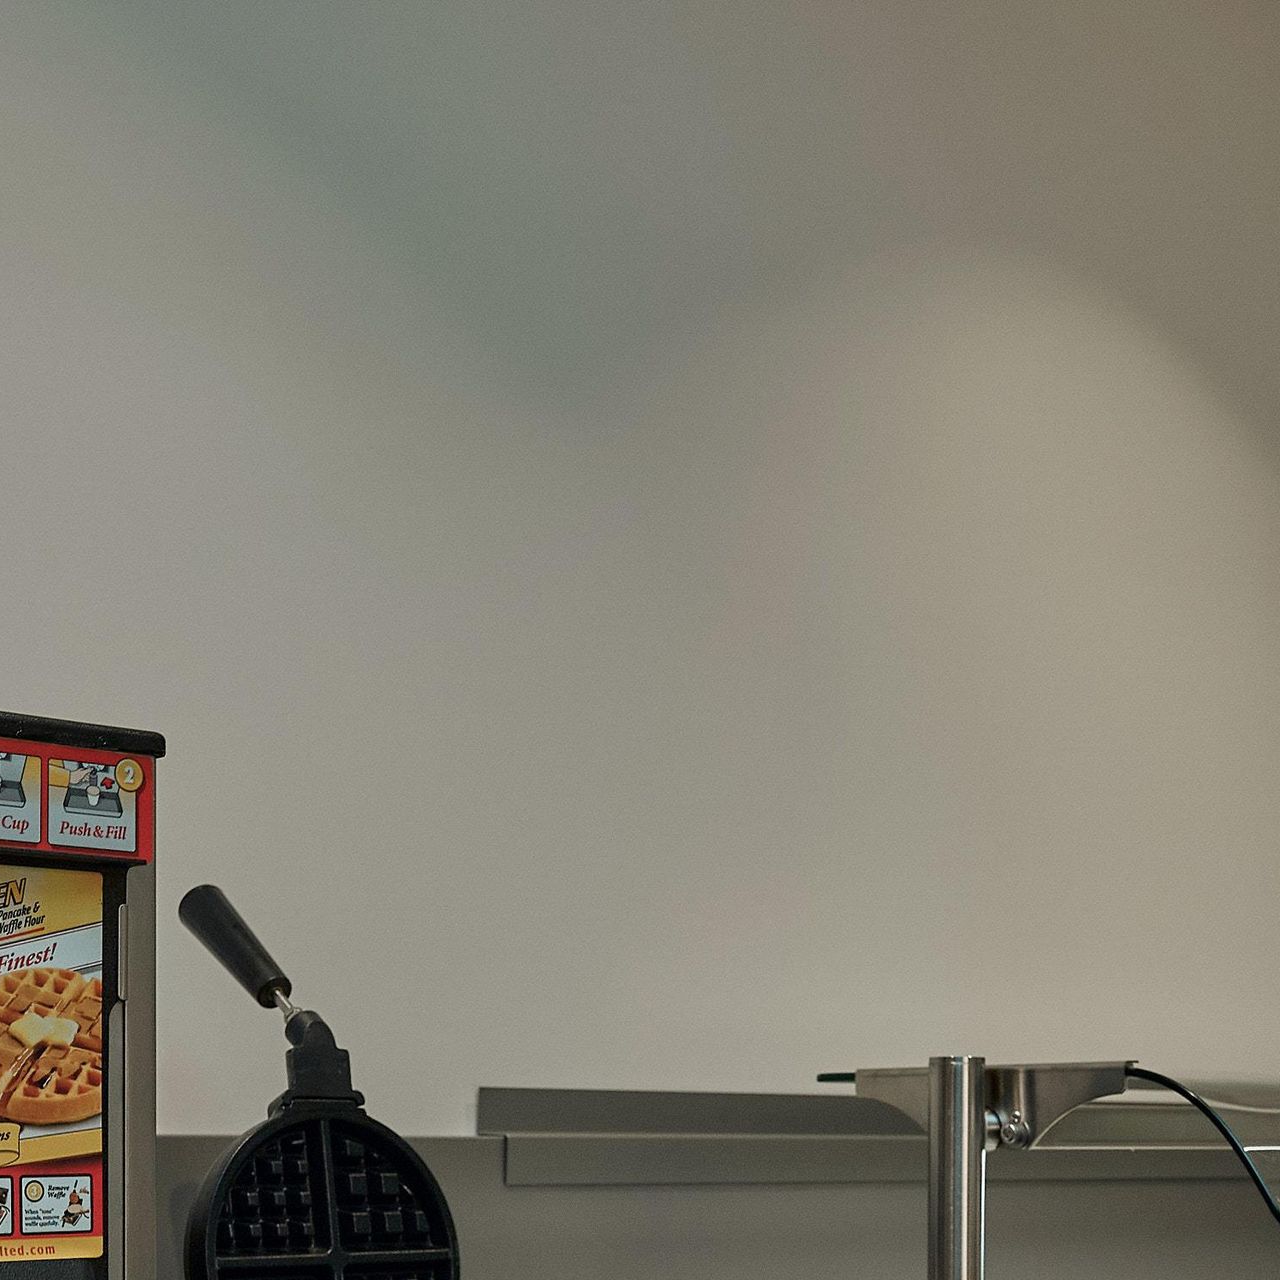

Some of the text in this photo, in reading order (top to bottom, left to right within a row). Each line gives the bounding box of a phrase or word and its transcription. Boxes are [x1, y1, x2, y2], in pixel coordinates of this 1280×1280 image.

[124, 766, 135, 784] 2
[1, 815, 29, 834] Cup
[59, 820, 127, 840] Push & Fill
[33, 901, 40, 913] &
[24, 914, 46, 929] Flour
